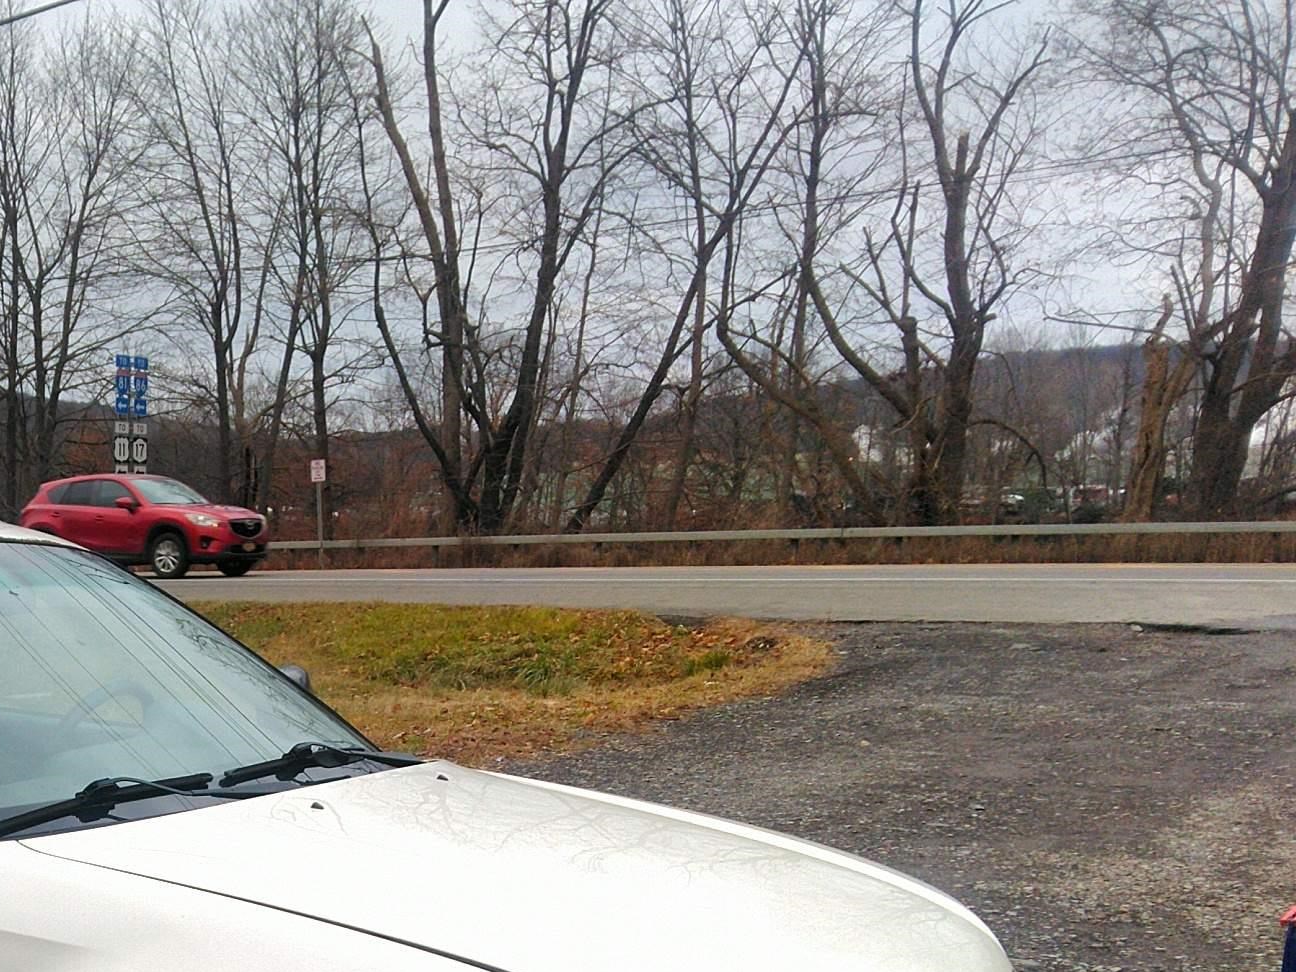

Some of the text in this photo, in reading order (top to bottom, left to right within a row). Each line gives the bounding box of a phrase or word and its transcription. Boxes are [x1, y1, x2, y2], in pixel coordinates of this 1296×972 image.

[118, 377, 127, 390] 81
[136, 379, 146, 391] 86
[118, 424, 126, 432] TO
[136, 424, 144, 433] TO
[119, 442, 126, 457] 11
[135, 444, 144, 458] 17
